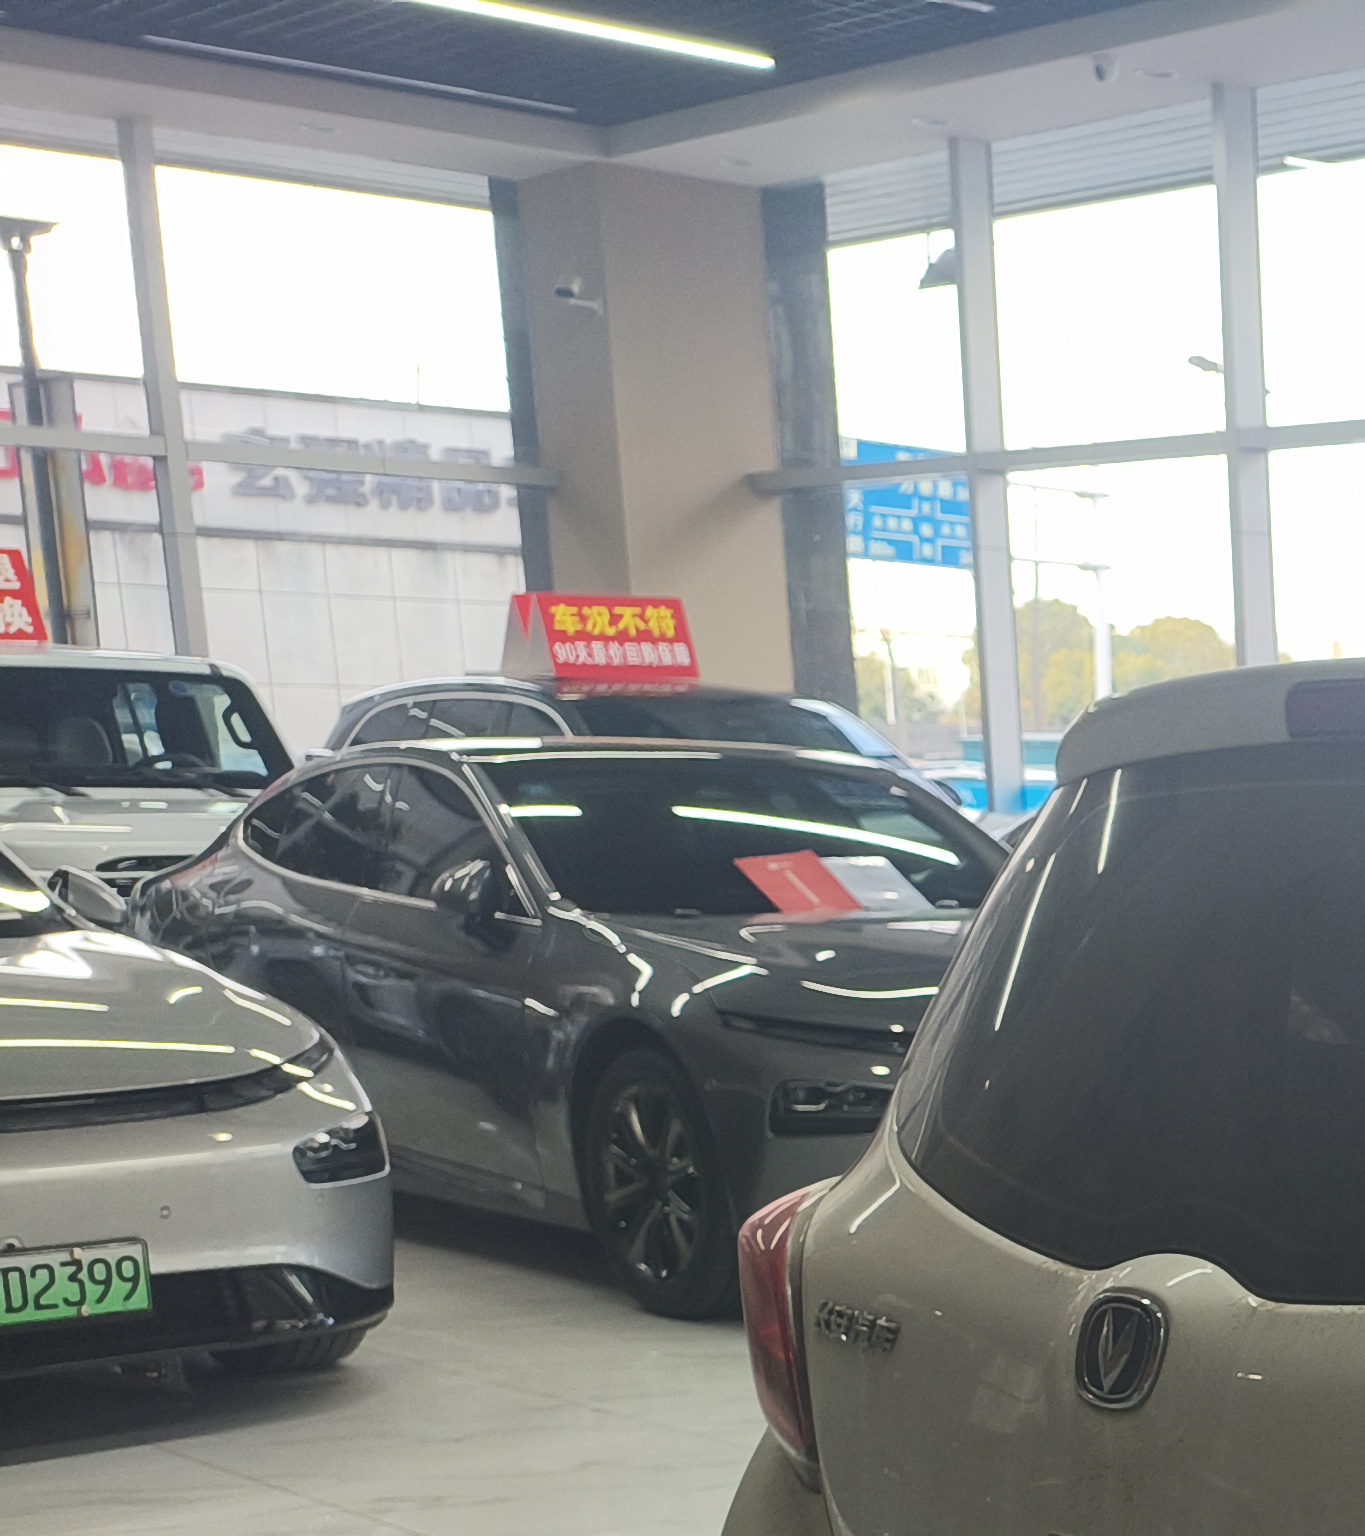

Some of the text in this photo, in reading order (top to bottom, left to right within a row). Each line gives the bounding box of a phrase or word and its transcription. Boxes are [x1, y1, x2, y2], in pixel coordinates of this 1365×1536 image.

[550, 603, 676, 638] 车况不符
[0, 1255, 141, 1314] D2399
